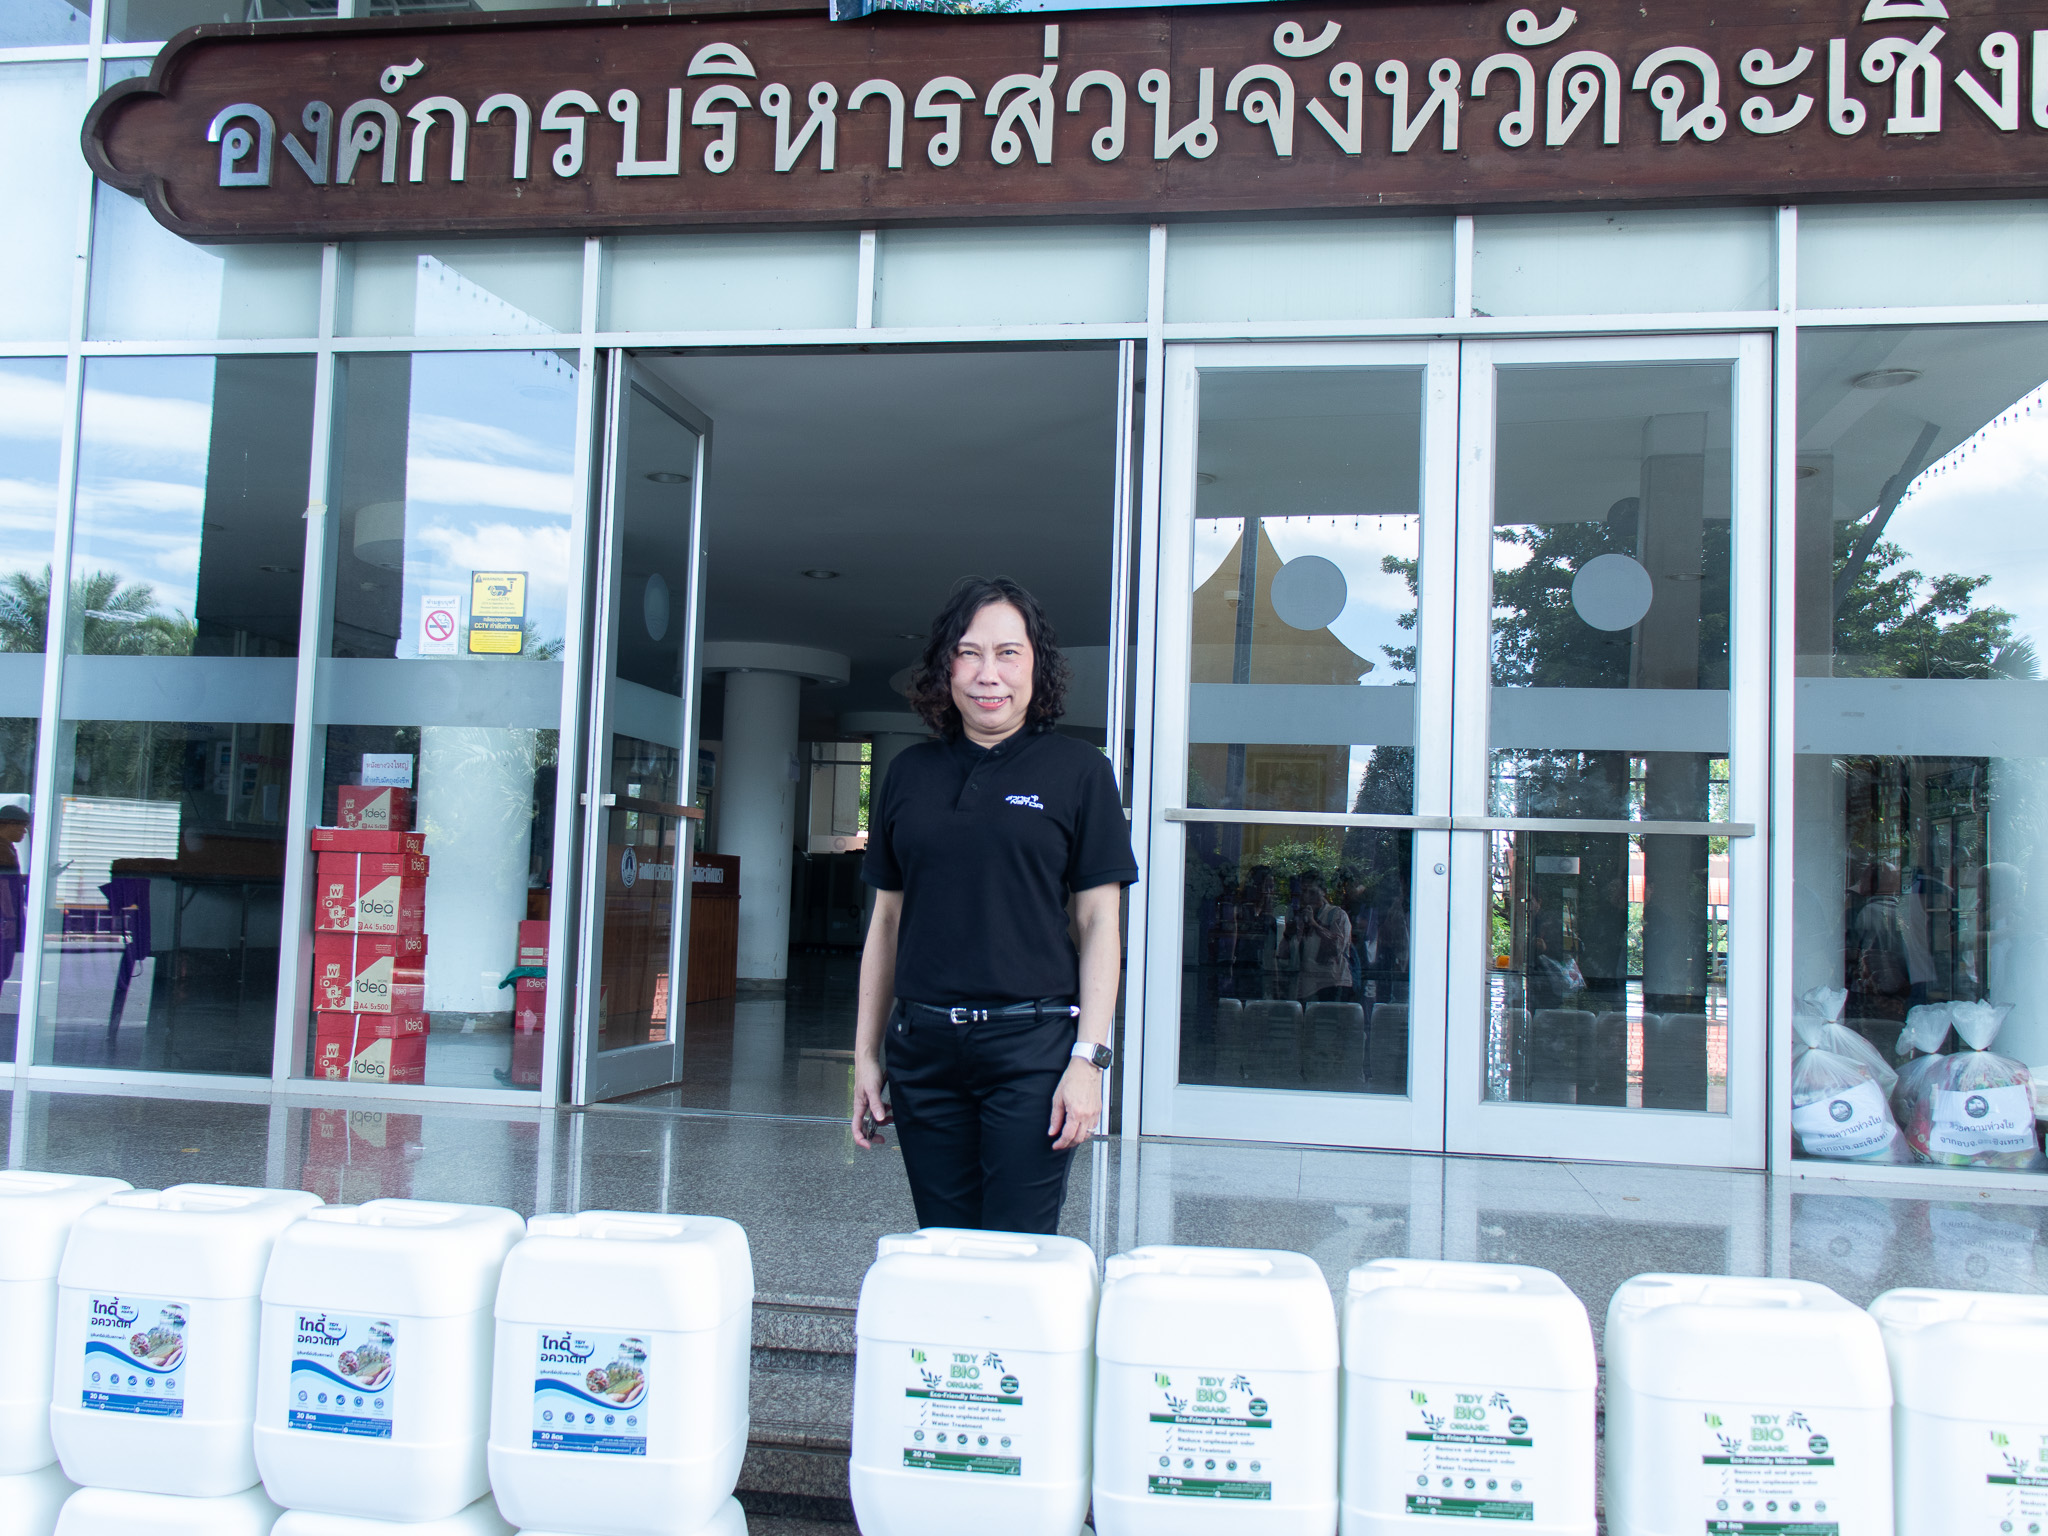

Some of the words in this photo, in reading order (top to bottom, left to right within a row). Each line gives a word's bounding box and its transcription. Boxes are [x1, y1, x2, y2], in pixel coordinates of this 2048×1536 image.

[365, 808, 386, 818] idea
[411, 858, 425, 871] idea
[360, 900, 394, 914] idea
[405, 937, 422, 951] idea
[356, 979, 388, 994] idea
[360, 1002, 368, 1010] A4
[370, 1002, 389, 1010] 5x500
[405, 1018, 424, 1032] idea
[354, 1060, 386, 1076] idea
[952, 1352, 978, 1364] TIDY
[950, 1364, 980, 1380] BIO
[946, 1380, 983, 1390] ORGANIC
[1198, 1376, 1225, 1387] TIDY
[930, 1390, 968, 1401] Eco-Friendly
[969, 1393, 998, 1402] Microbes
[1196, 1388, 1228, 1403] BIO
[1455, 1393, 1484, 1404] TIDY
[296, 1412, 304, 1420] 20
[1454, 1405, 1486, 1420] BIO
[541, 1432, 550, 1440] 20
[1750, 1427, 1784, 1442] BIO
